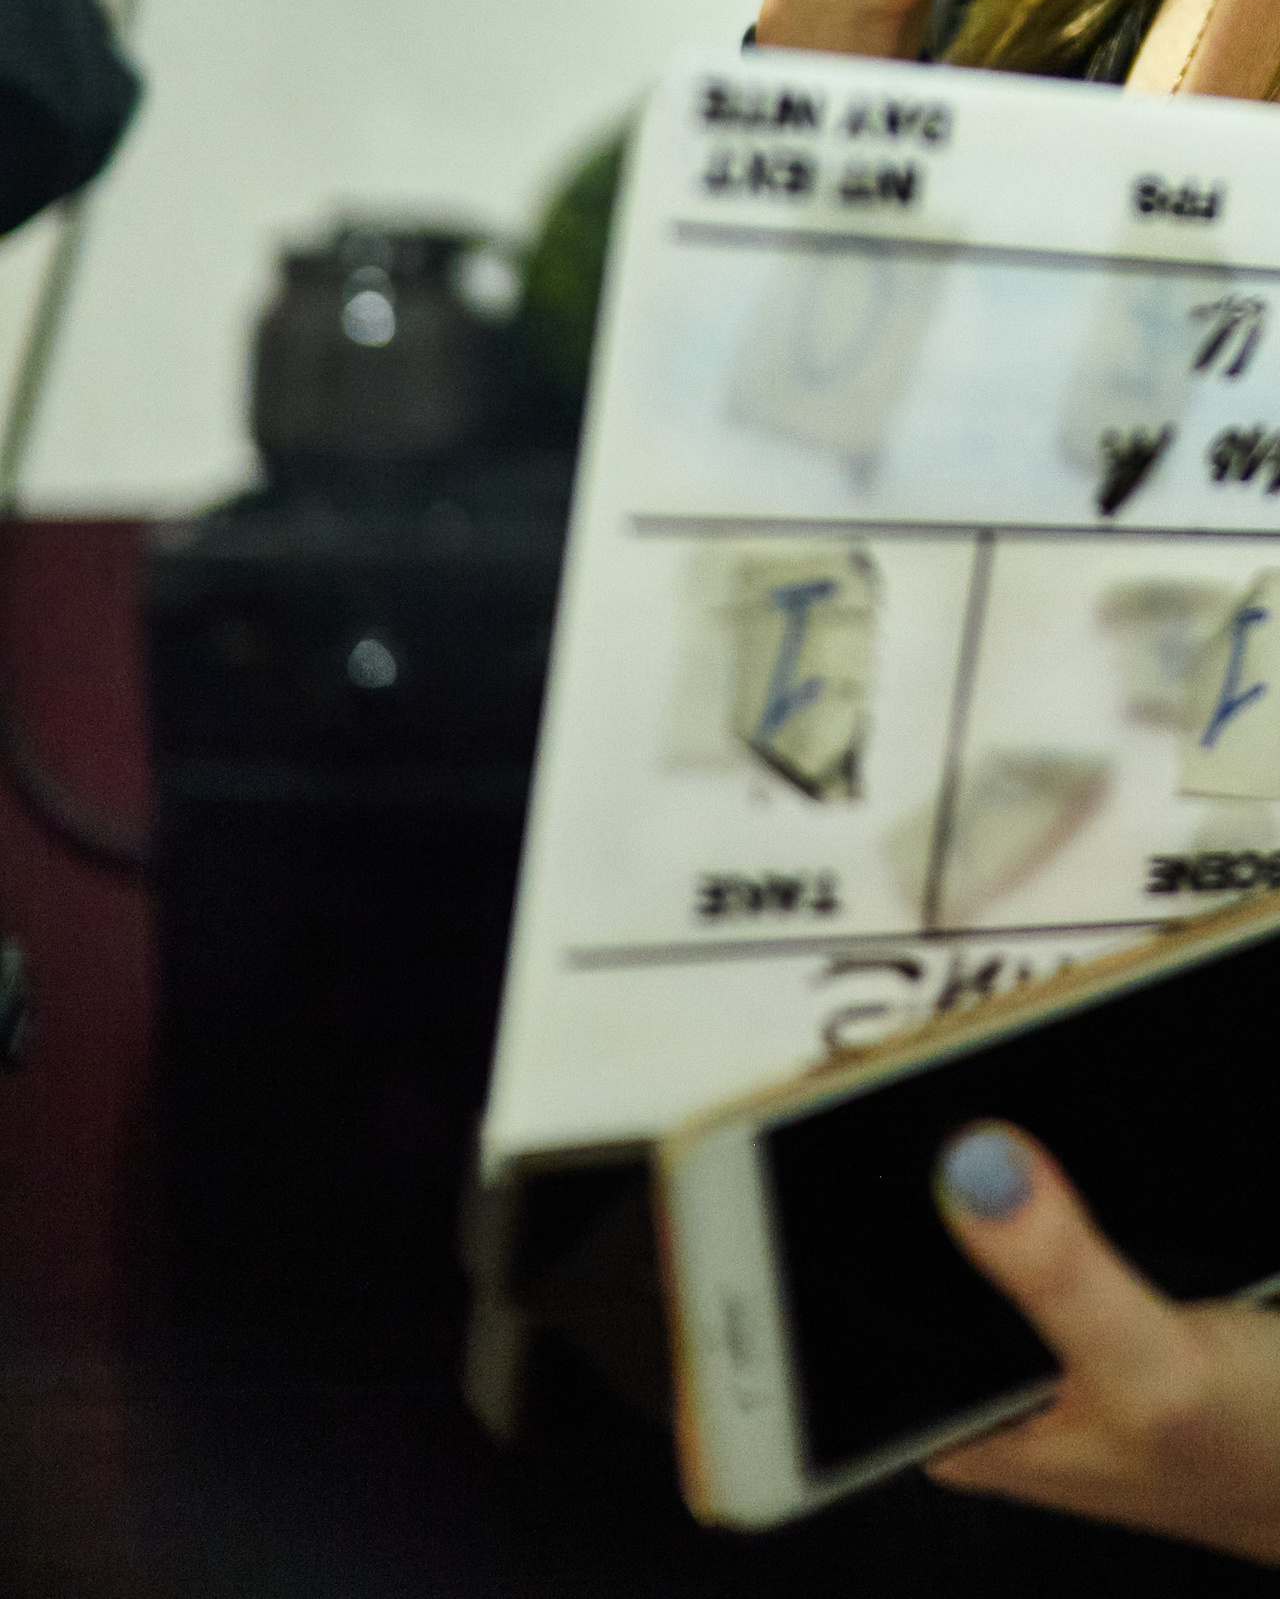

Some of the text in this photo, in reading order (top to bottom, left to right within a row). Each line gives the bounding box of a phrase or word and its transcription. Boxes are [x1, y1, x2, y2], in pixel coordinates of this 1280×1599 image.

[1133, 175, 1223, 225] FPS
[1197, 603, 1271, 751] 1
[693, 867, 843, 921] TAKE
